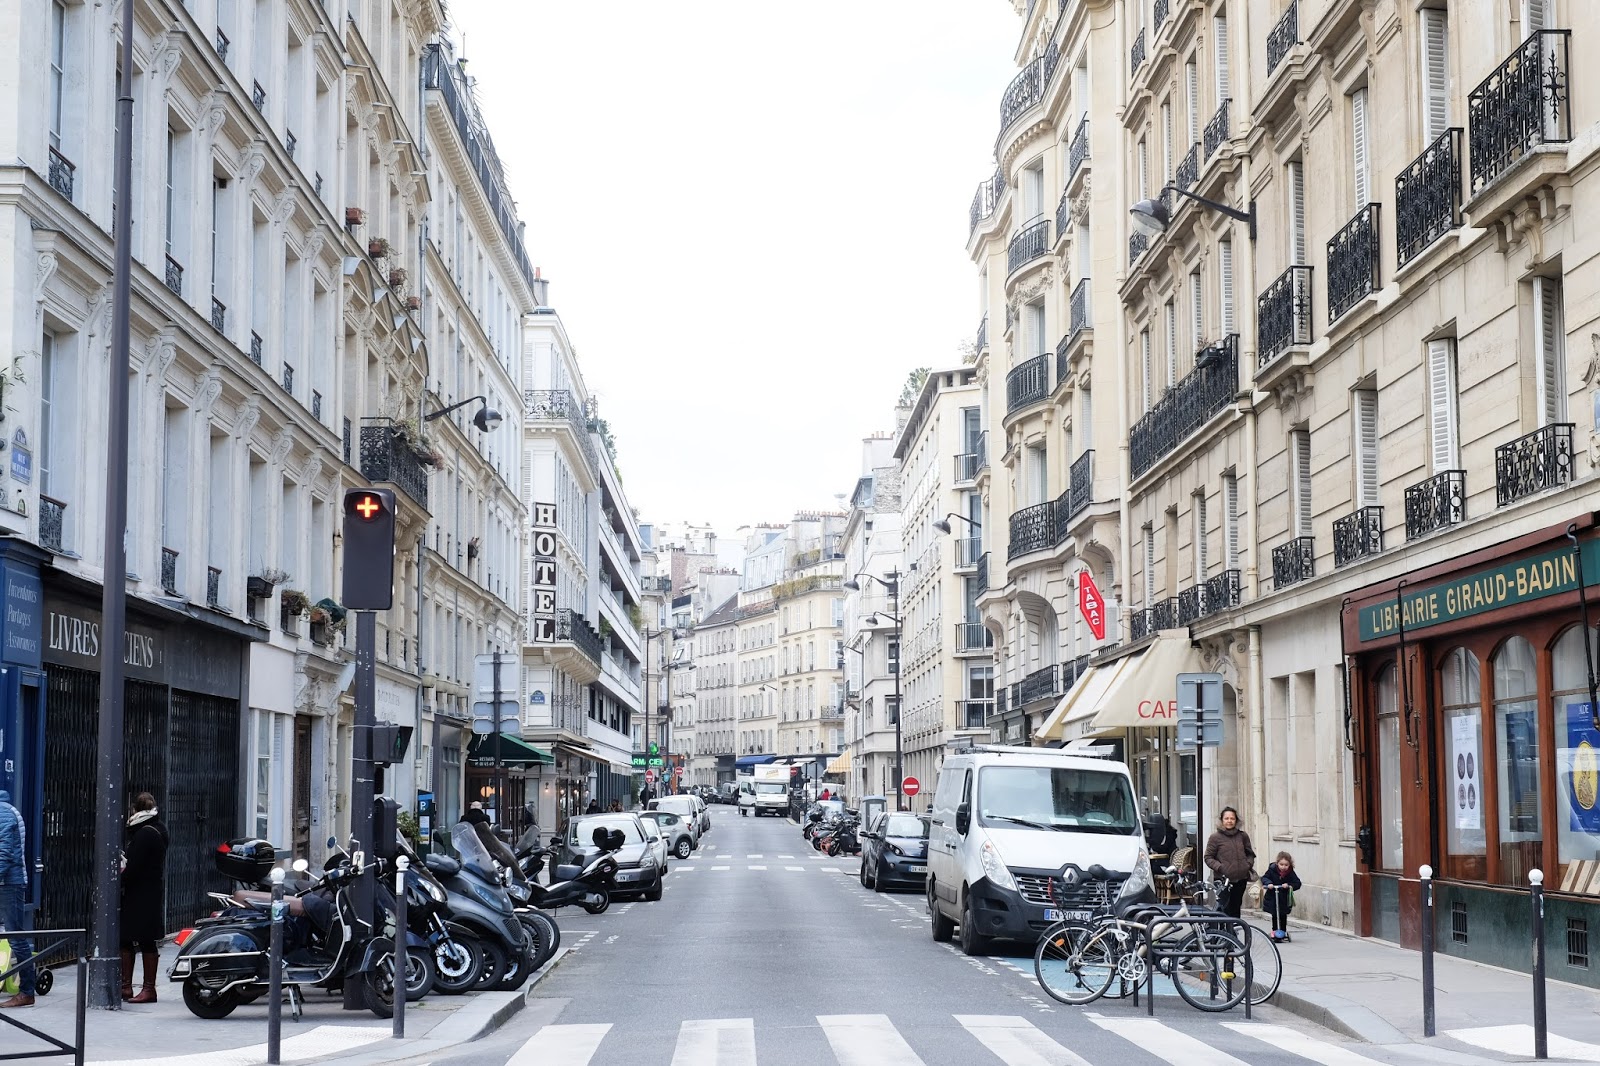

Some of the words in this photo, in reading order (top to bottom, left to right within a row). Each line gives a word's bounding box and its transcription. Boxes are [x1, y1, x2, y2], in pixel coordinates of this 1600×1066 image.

[535, 502, 556, 643] HOTEL
[1372, 593, 1438, 633] LIBRAIRIE
[1446, 553, 1576, 615] GIRAUD-BADIN
[1084, 586, 1100, 625] TABAC
[49, 612, 99, 657] LIVRES
[123, 630, 153, 668] CIENS
[1138, 700, 1177, 719] CAF
